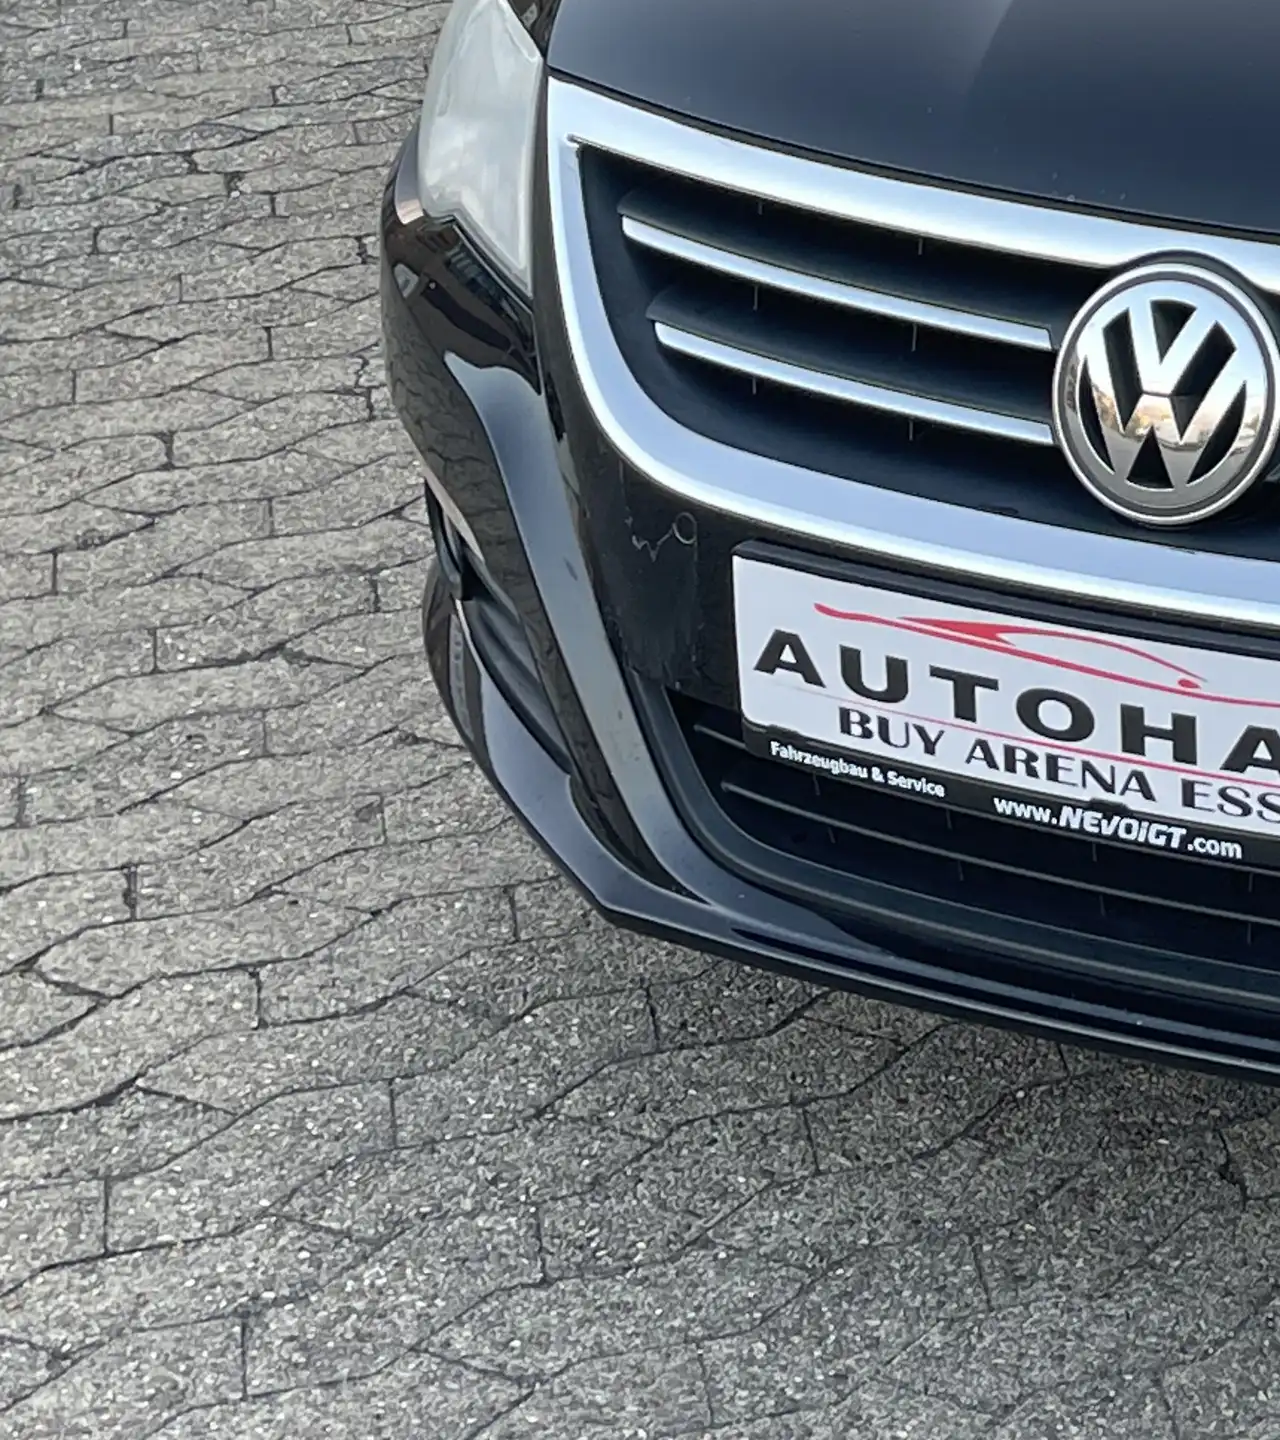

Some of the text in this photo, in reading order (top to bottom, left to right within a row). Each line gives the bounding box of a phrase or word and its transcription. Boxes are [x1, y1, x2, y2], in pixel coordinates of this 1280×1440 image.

[770, 740, 946, 798] Fahrzeugbau & Service
[838, 706, 946, 757] BUY
[964, 738, 1158, 803] ARENA
